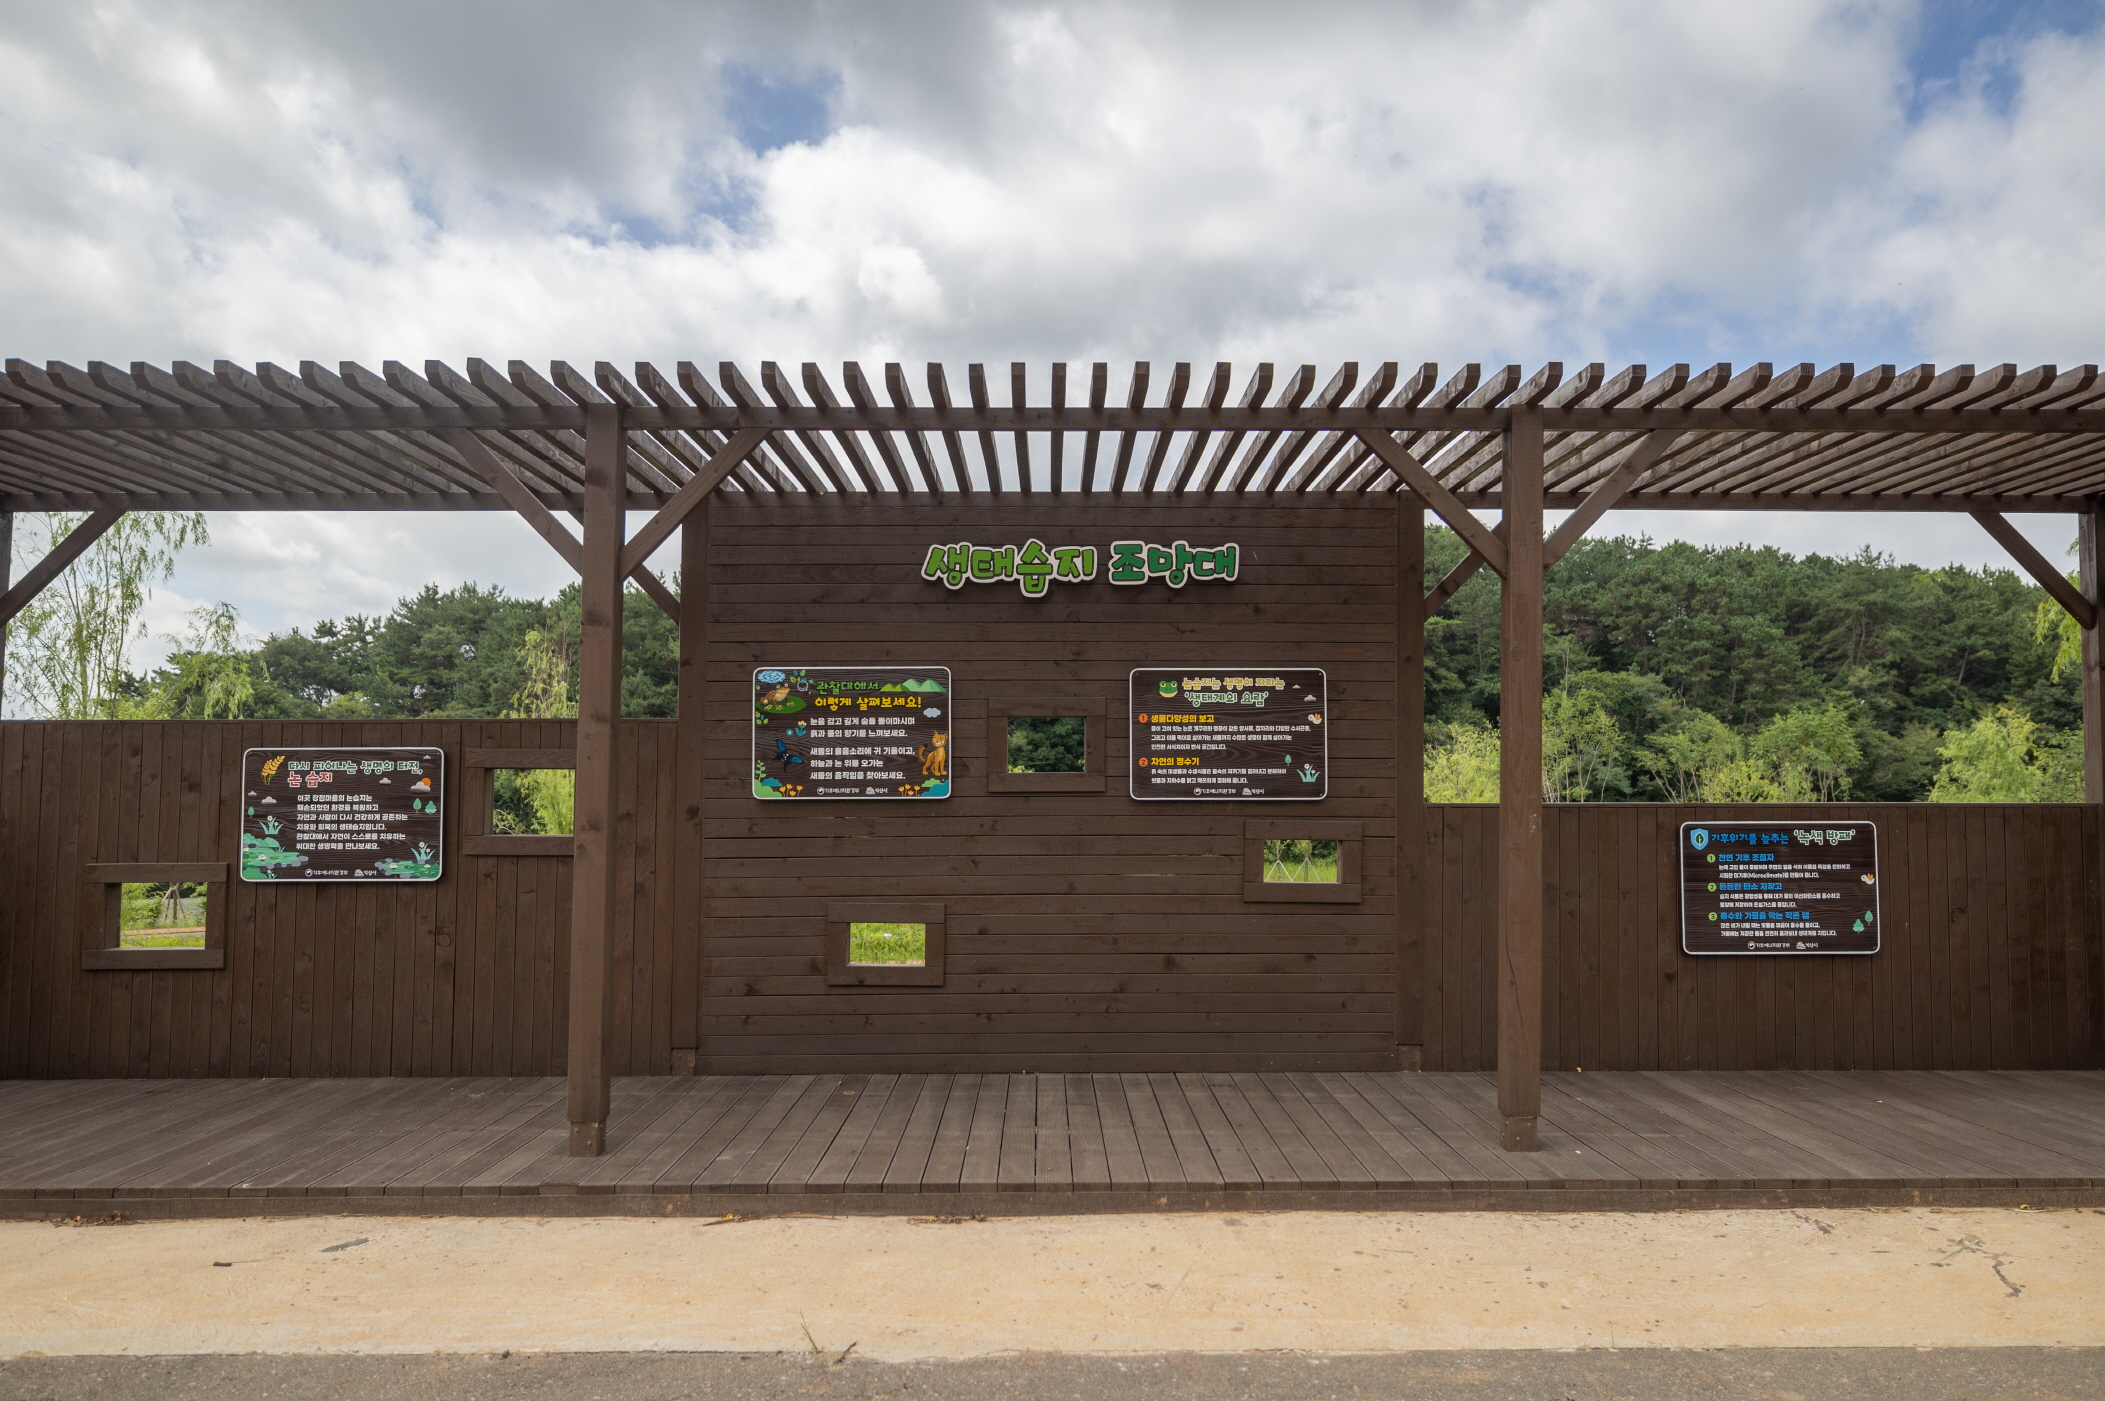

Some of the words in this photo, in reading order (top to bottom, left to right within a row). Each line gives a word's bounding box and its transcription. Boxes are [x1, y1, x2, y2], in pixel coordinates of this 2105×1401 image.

[921, 538, 1098, 598] 생태습지
[1109, 540, 1240, 589] 조망대
[816, 681, 878, 694] 관찰대에서
[1182, 678, 1221, 690] 논습지는
[1223, 678, 1253, 690] 생명이
[1256, 678, 1285, 690] 자라는
[815, 697, 851, 711] 이렇게
[856, 696, 922, 710] 살펴보세요!
[1184, 692, 1237, 707] ‘생태계의
[1241, 692, 1269, 707] 요람’
[811, 717, 825, 726] 눈을
[827, 717, 842, 726] 감고
[844, 717, 859, 726] 깊게
[860, 717, 876, 726] 숨을
[878, 717, 914, 726] 들이마시며
[811, 729, 825, 738] 흙과
[827, 729, 842, 738] 풀의
[844, 729, 866, 738] 향기를
[868, 729, 907, 738] 느껴보세요.
[811, 747, 833, 756] 새들의
[834, 747, 872, 756] 울음소리에
[874, 747, 881, 756] 귀
[883, 747, 915, 756] 기울이고,
[811, 759, 833, 768] 하늘과
[834, 759, 842, 768] 논
[844, 759, 859, 768] 위를
[860, 759, 883, 768] 오가는
[1152, 757, 1174, 766] 자연의
[1176, 757, 1199, 766] 정수기
[288, 762, 310, 770] 다시
[313, 762, 357, 774] 피어나는
[360, 761, 394, 774] 생명의
[397, 762, 423, 774] 터전,
[288, 771, 302, 788] 논
[306, 772, 332, 788] 습지
[811, 771, 832, 780] 새들의
[834, 771, 864, 780] 움직임을
[866, 771, 905, 780] 찾아보세요.
[1711, 833, 1757, 845] 기후위기를
[1761, 833, 1790, 844] 늦추는
[1794, 830, 1823, 845] ‘녹색
[1826, 829, 1856, 845] 방패’
[1735, 853, 1750, 862] 기후
[1752, 853, 1774, 862] 조절자
[1720, 882, 1741, 891] 든든한
[1743, 882, 1758, 891] 탄소
[1760, 882, 1782, 891] 저장고
